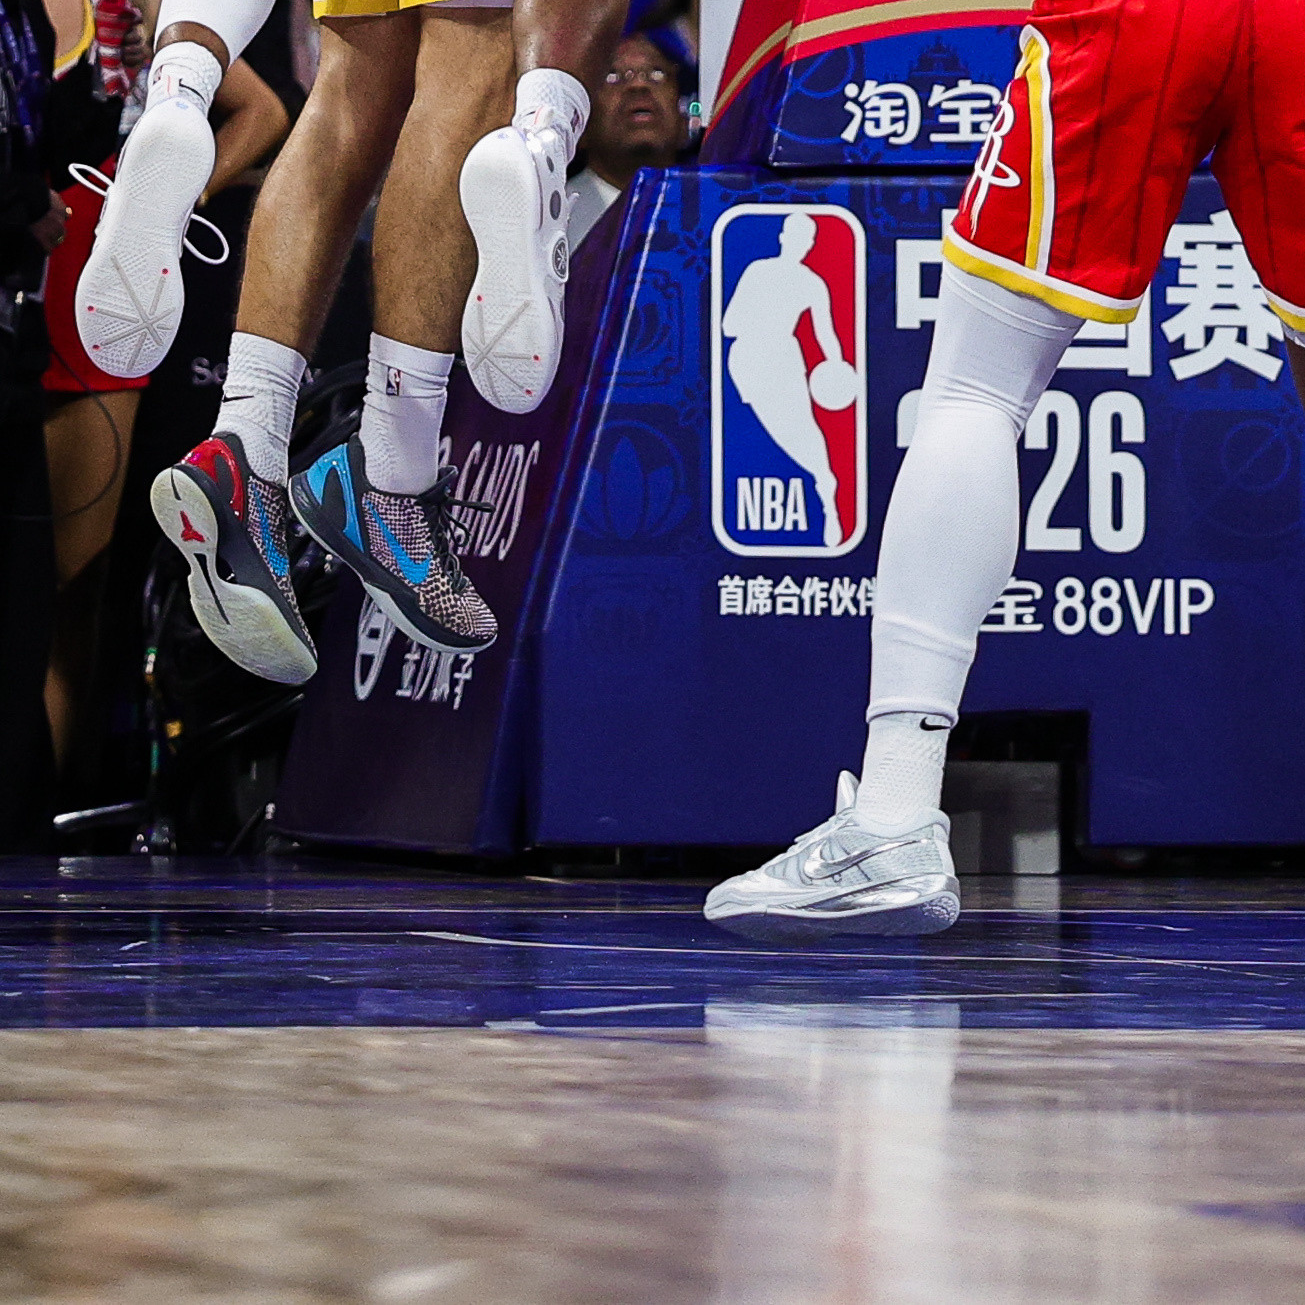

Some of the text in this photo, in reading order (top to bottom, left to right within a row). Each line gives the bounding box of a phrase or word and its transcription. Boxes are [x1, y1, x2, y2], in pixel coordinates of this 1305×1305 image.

[841, 79, 1002, 145] 淘宝
[736, 477, 809, 532] NBA
[979, 580, 1044, 633] 宝
[1052, 577, 1216, 636] 88VIP
